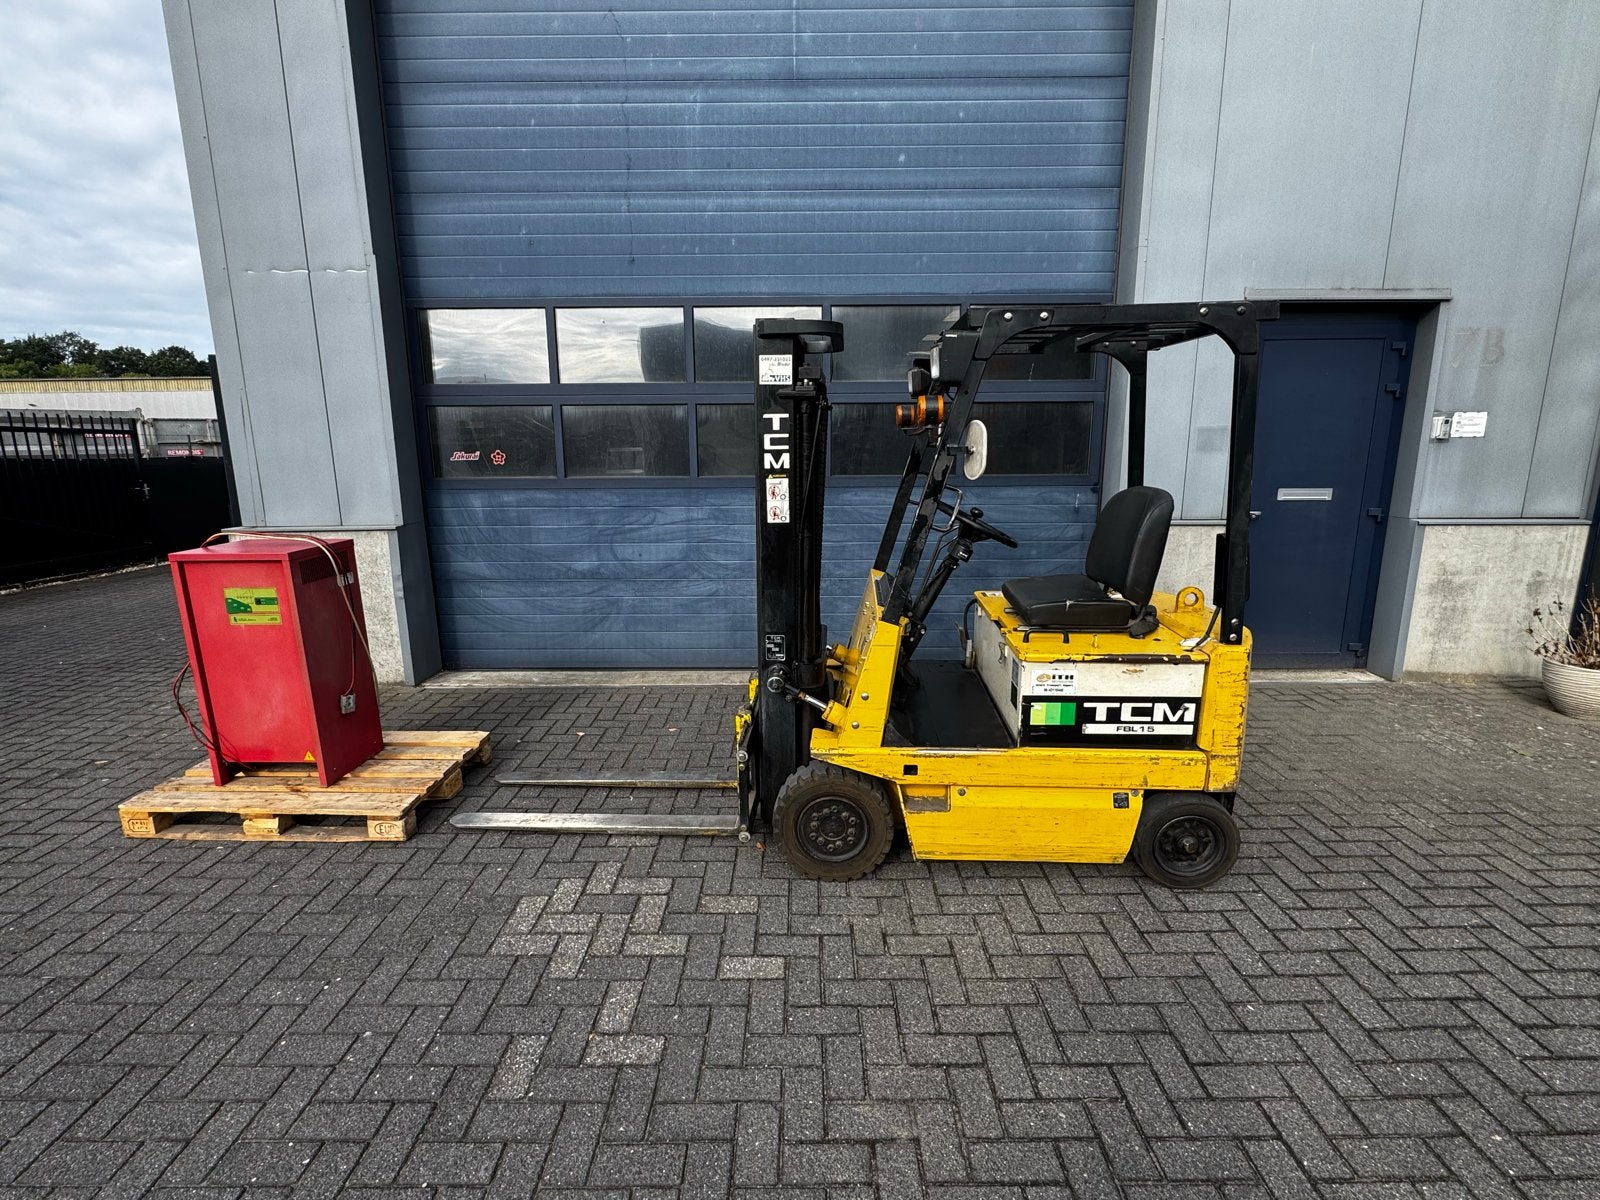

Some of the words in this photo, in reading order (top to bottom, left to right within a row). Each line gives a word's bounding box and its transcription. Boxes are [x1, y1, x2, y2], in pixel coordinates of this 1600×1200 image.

[762, 413, 790, 469] TCM
[450, 451, 480, 461] Sakurai
[1083, 702, 1196, 722] TCM
[1116, 725, 1155, 733] FBL15
